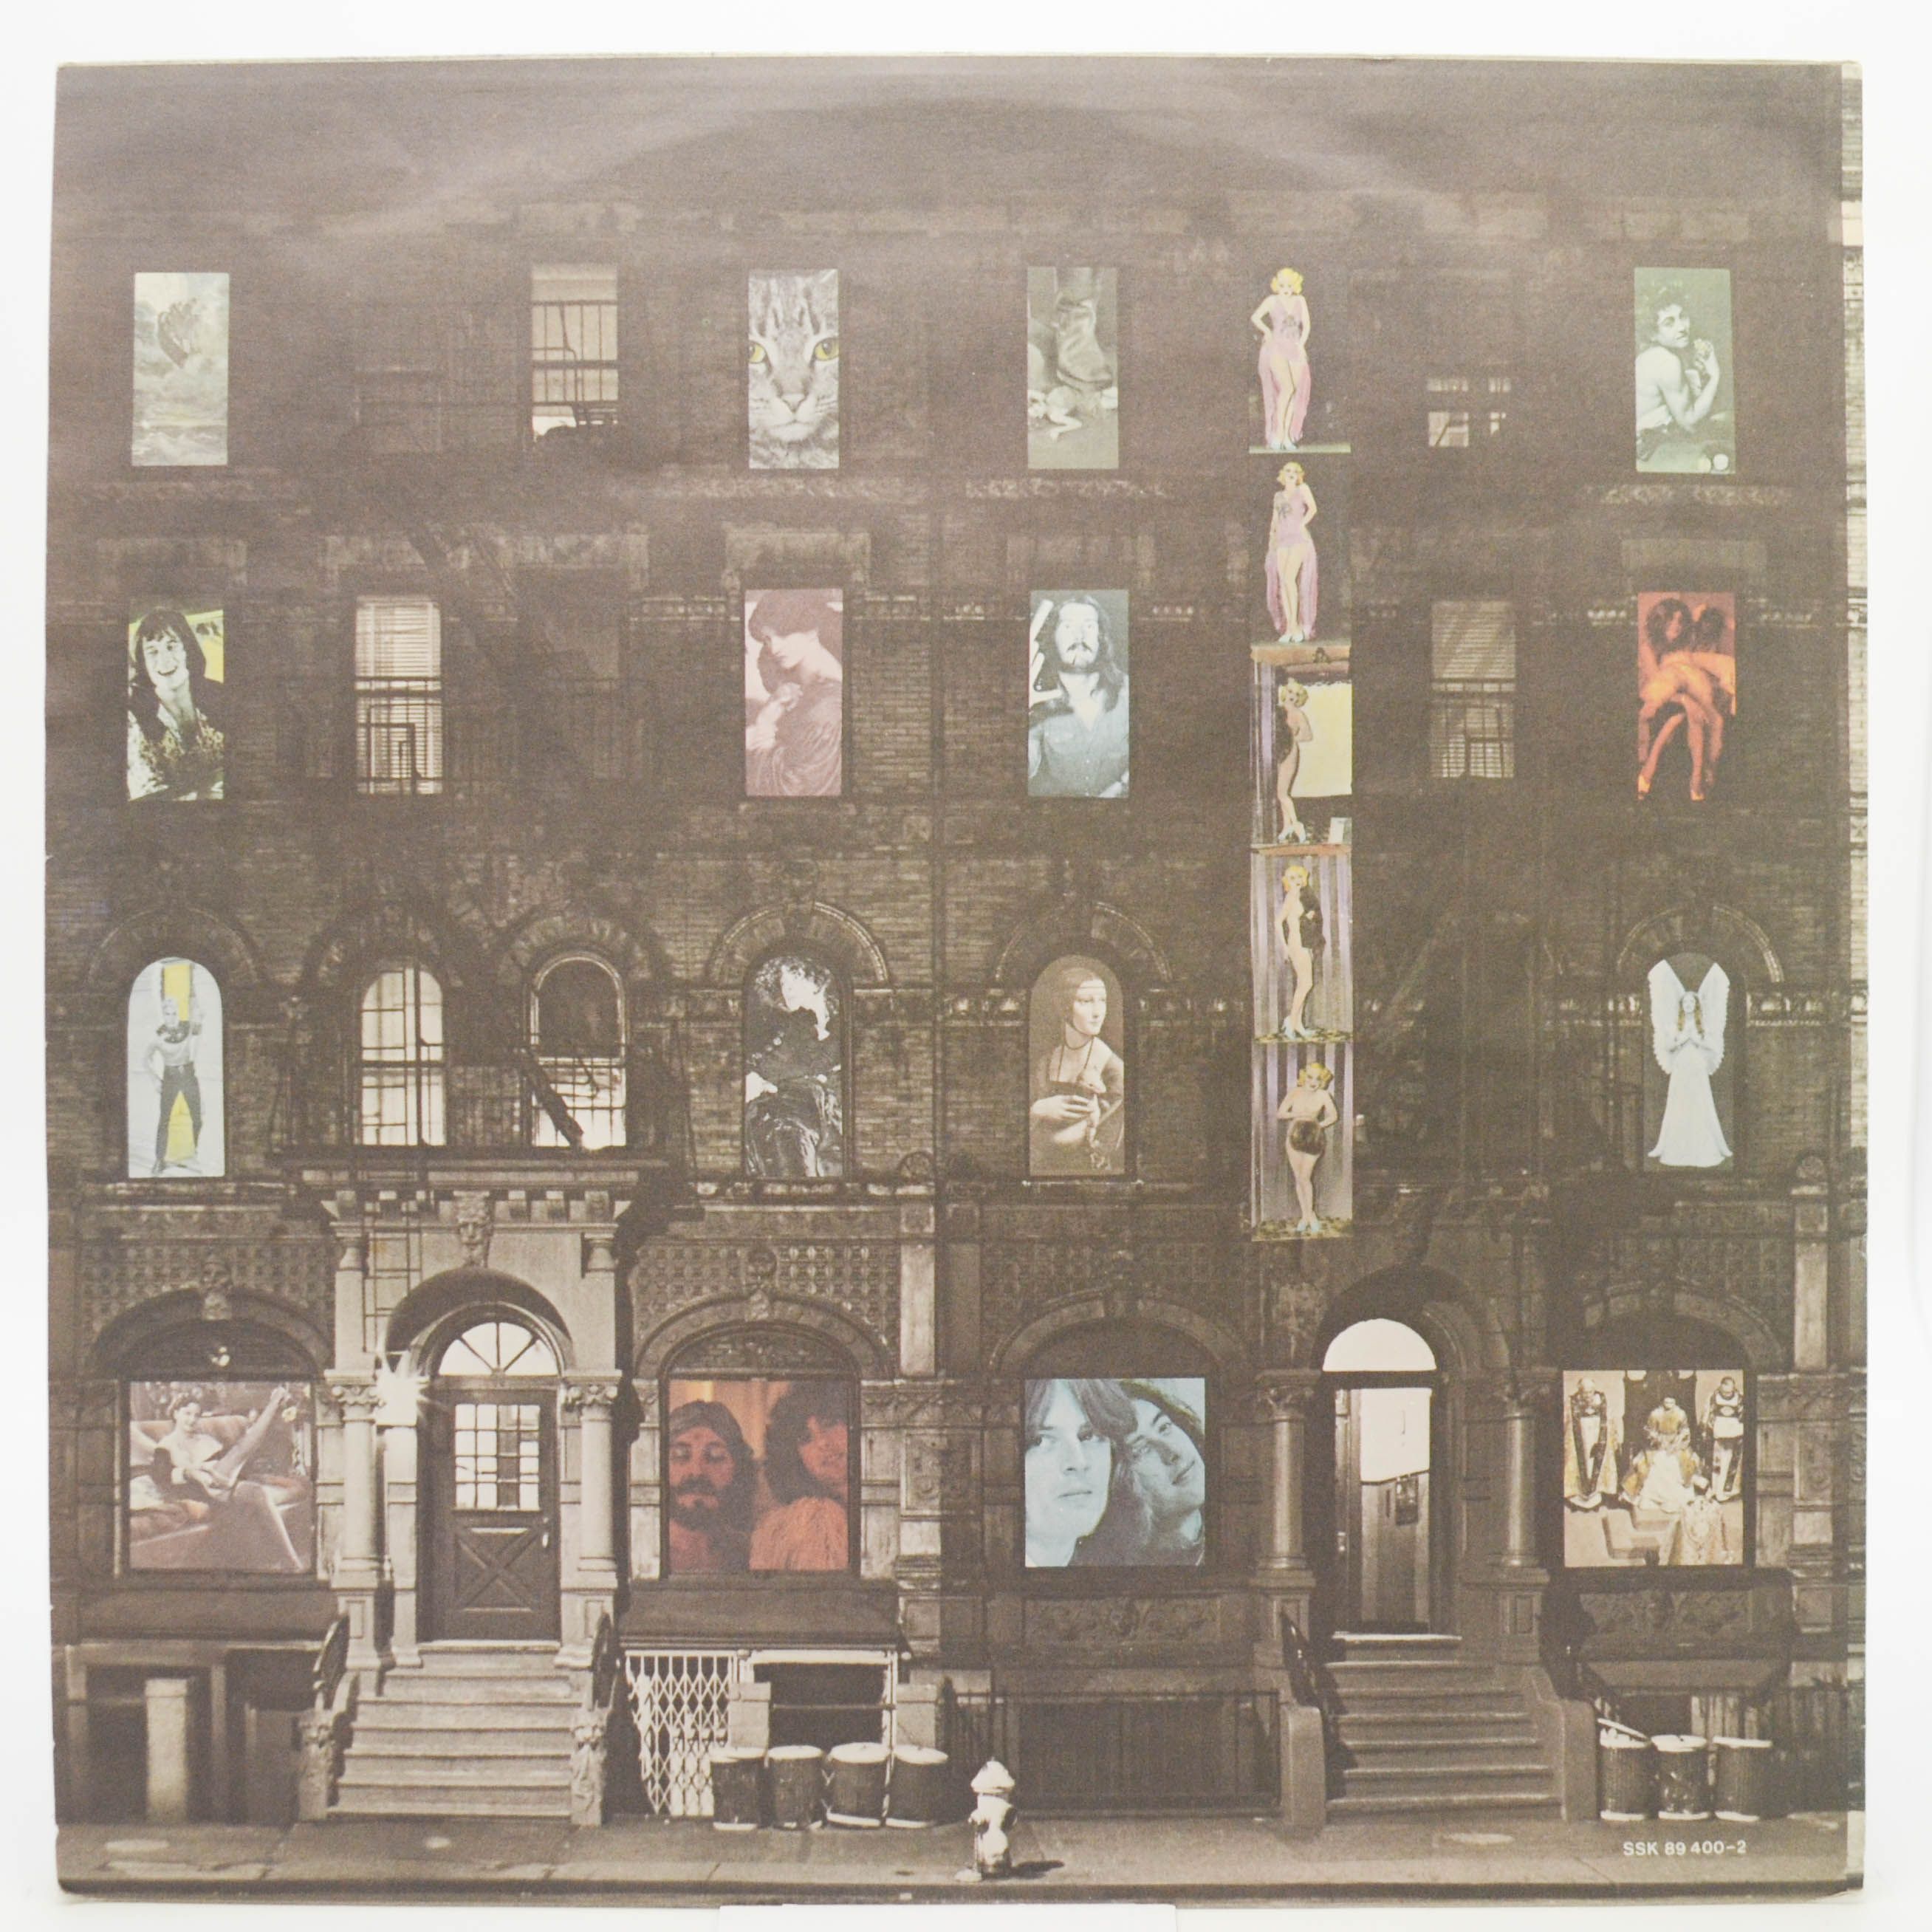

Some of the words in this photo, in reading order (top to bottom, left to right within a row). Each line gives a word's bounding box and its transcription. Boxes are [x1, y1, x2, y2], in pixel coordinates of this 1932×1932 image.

[1623, 1841, 1659, 1856] SSK
[1664, 1841, 1686, 1856] 89
[1690, 1840, 1747, 1854] 400-2
